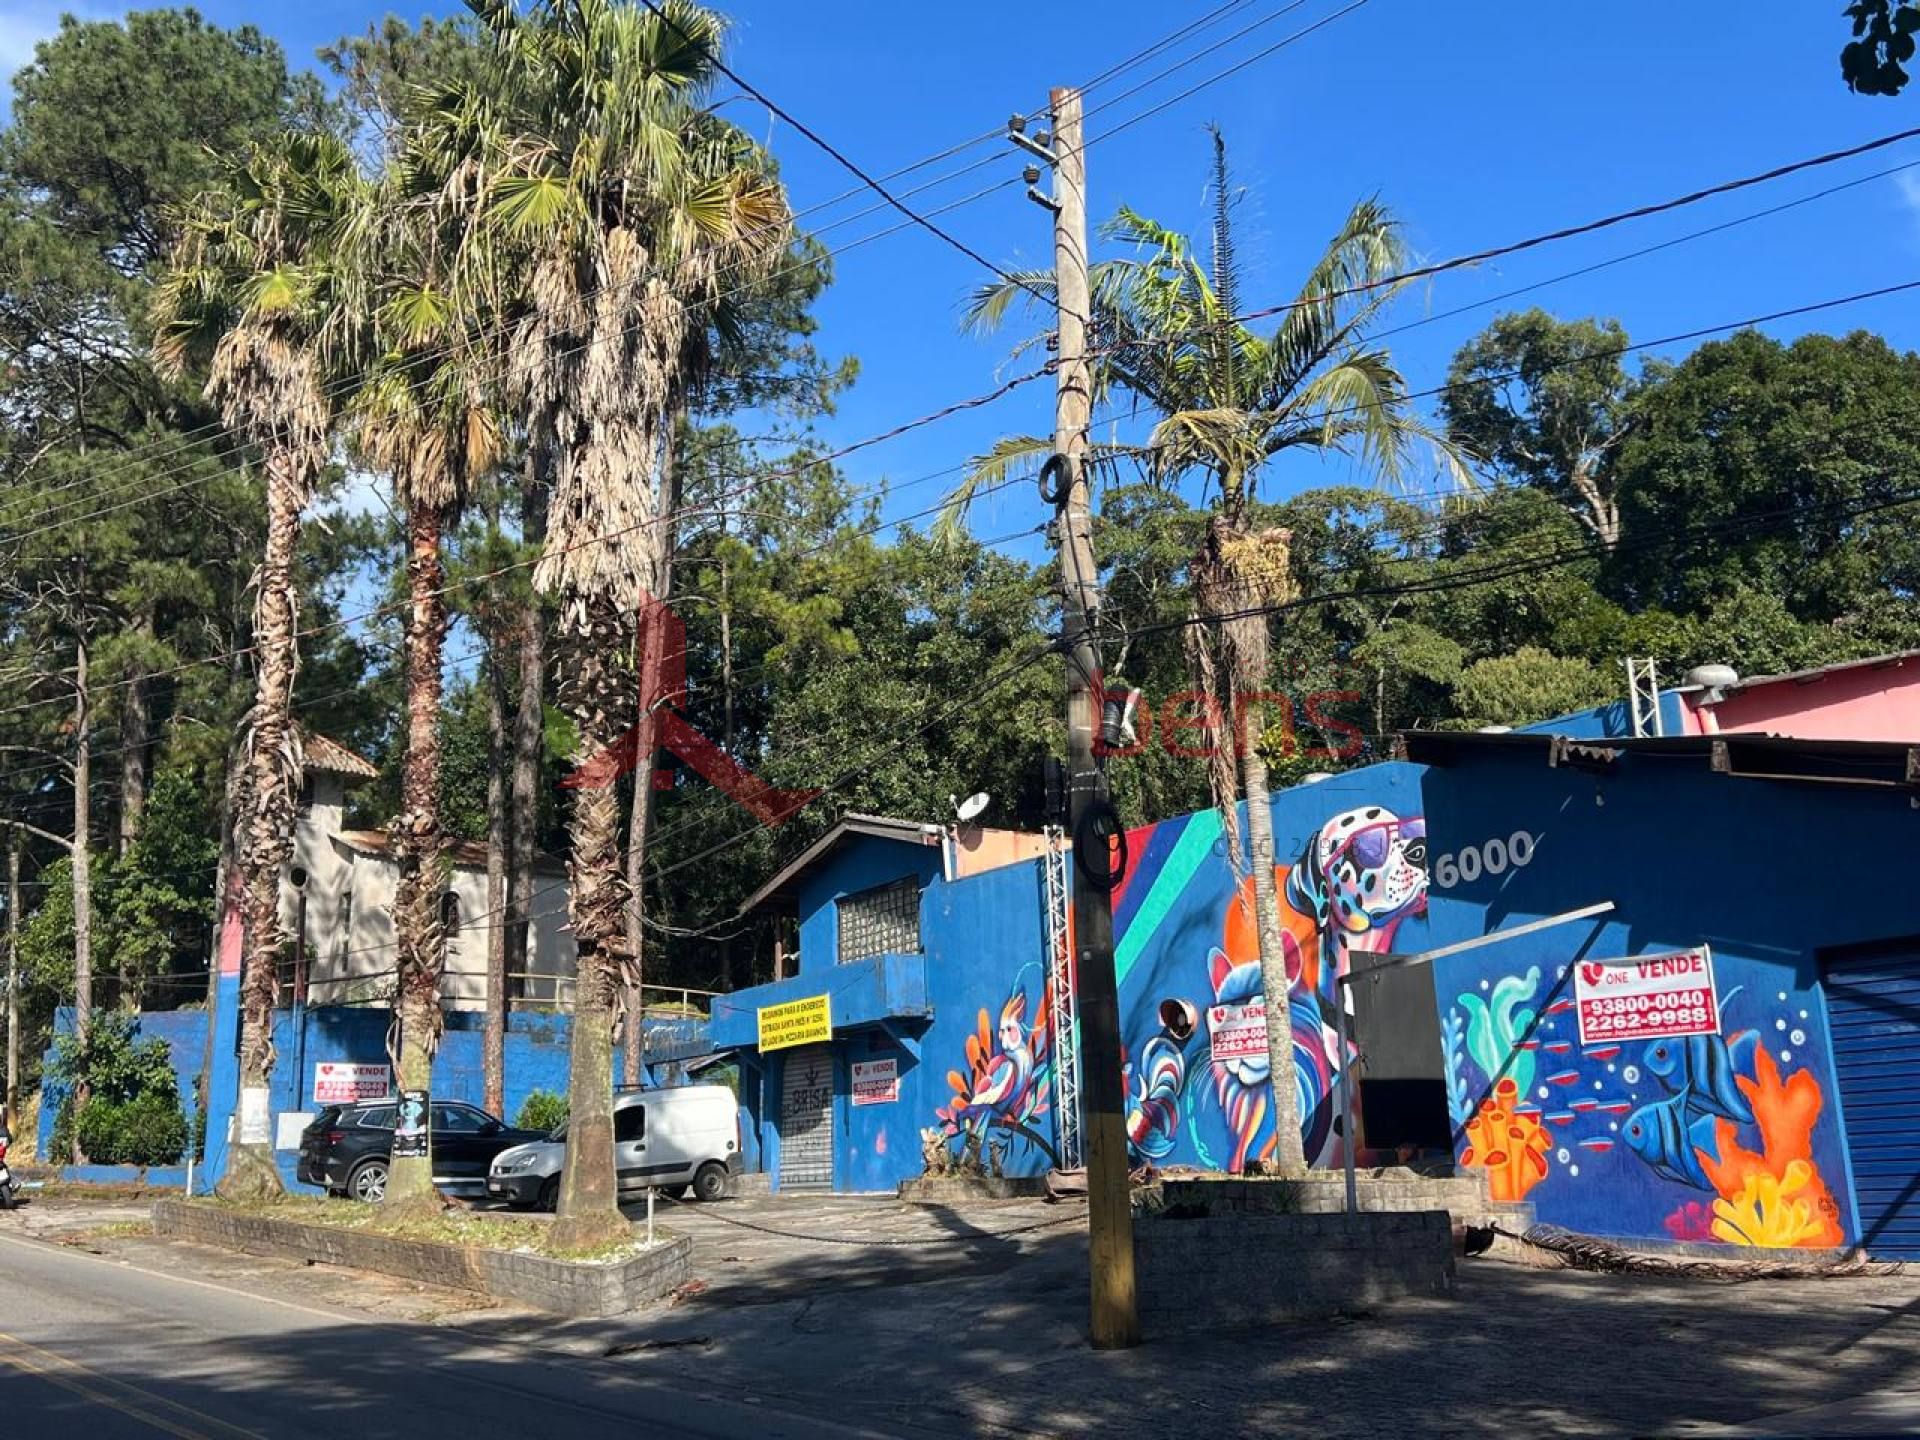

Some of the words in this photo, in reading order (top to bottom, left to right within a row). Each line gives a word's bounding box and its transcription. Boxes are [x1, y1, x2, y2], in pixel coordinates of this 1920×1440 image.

[1436, 830, 1533, 888] 6000
[1606, 972, 1630, 984] ONE
[1636, 955, 1703, 979] VENDE
[1590, 990, 1705, 1016] 93800-0040
[1586, 1007, 1708, 1031] 2262-9988
[352, 1067, 386, 1075] VENDE
